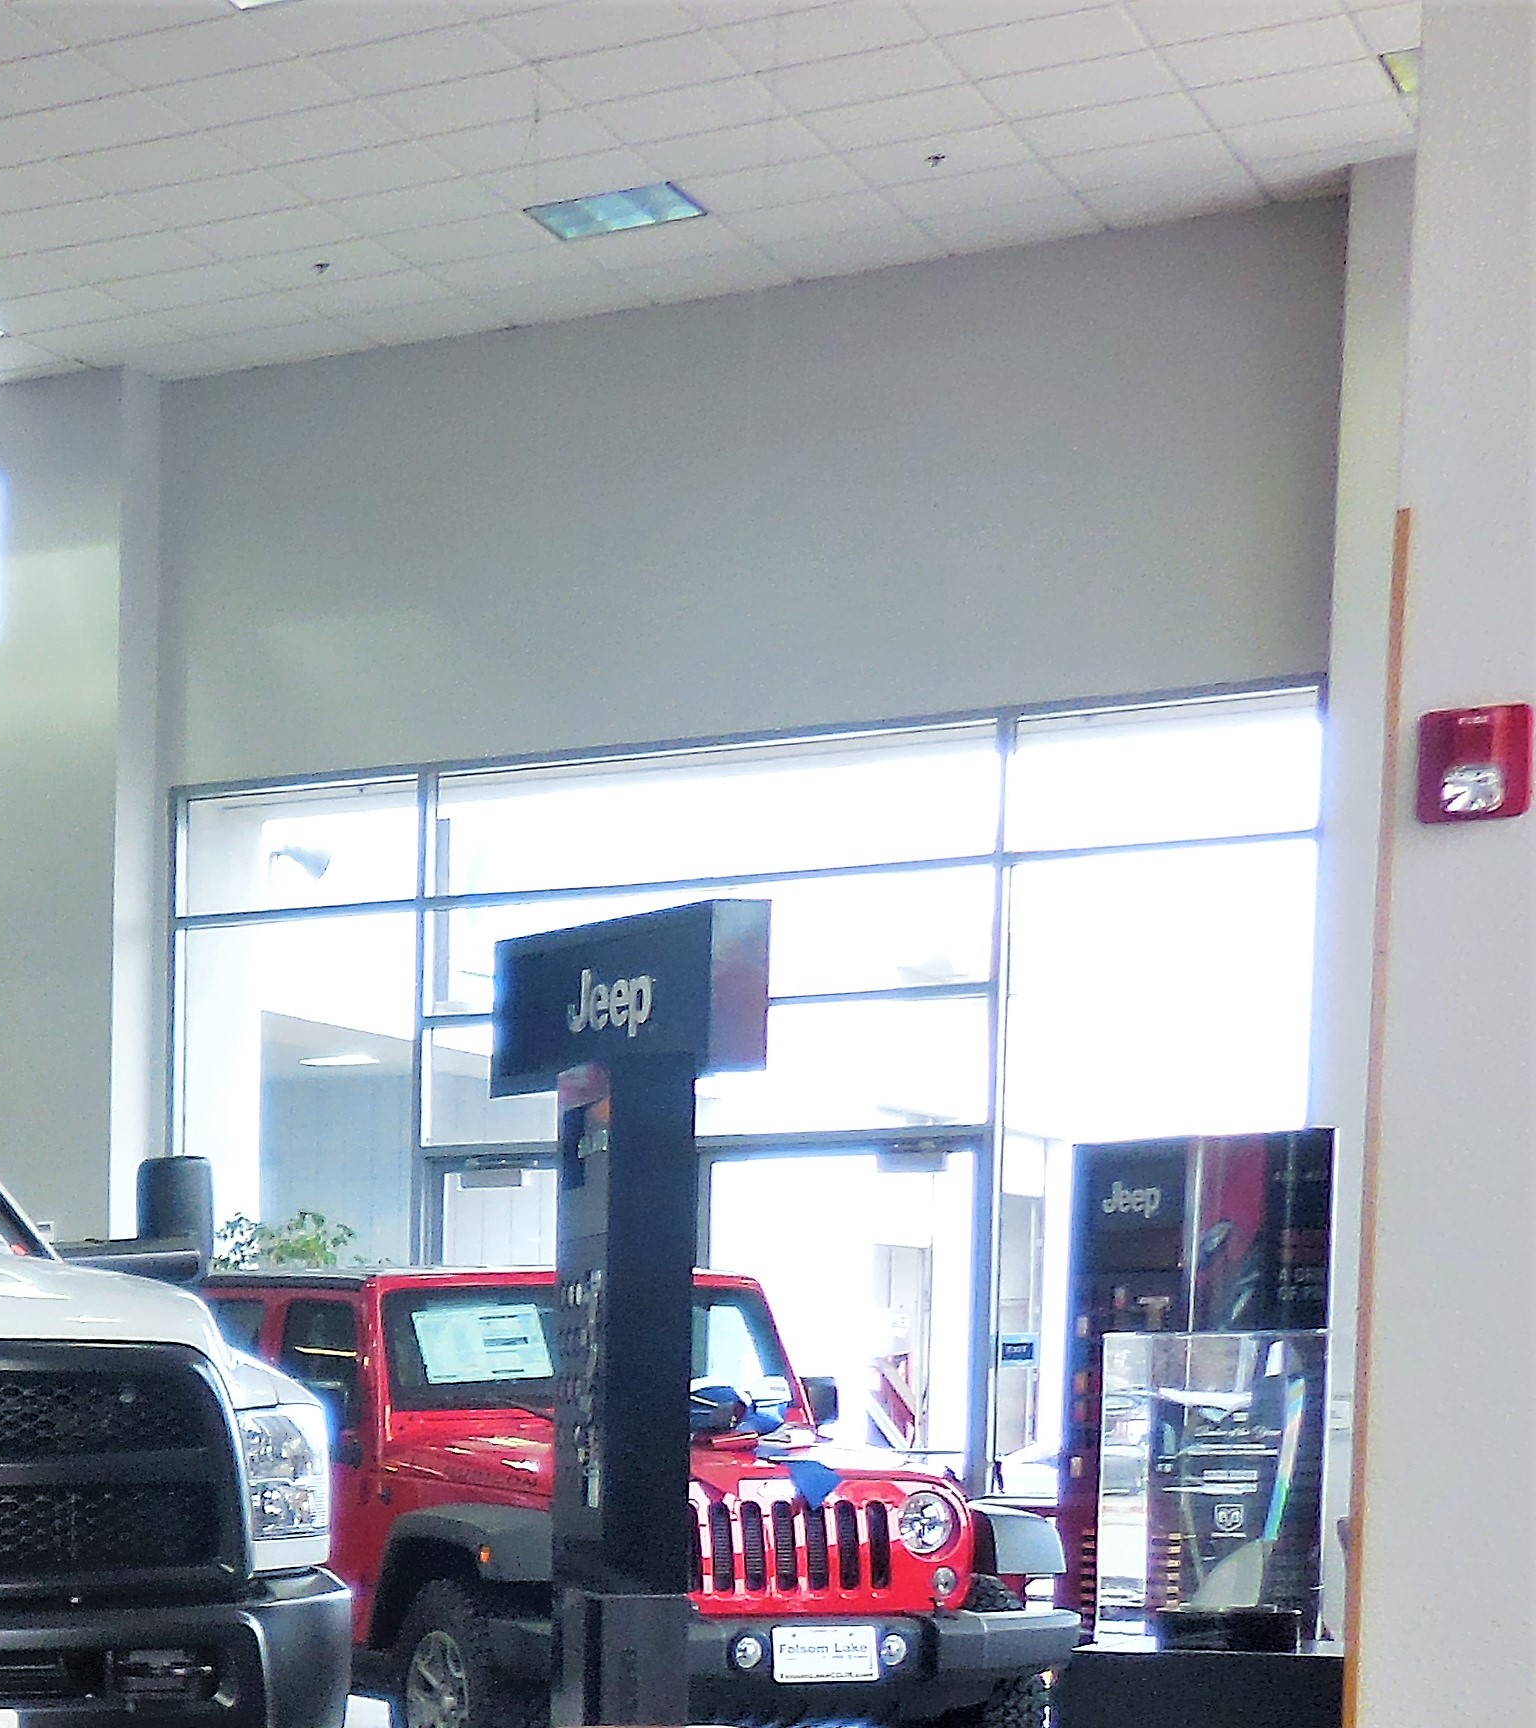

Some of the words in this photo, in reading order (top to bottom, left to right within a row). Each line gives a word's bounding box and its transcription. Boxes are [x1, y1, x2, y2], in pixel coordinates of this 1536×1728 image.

[568, 968, 652, 1037] Jeep
[1103, 1181, 1159, 1218] Jeep
[779, 1644, 828, 1654] Folsom
[834, 1643, 868, 1653] Lake
